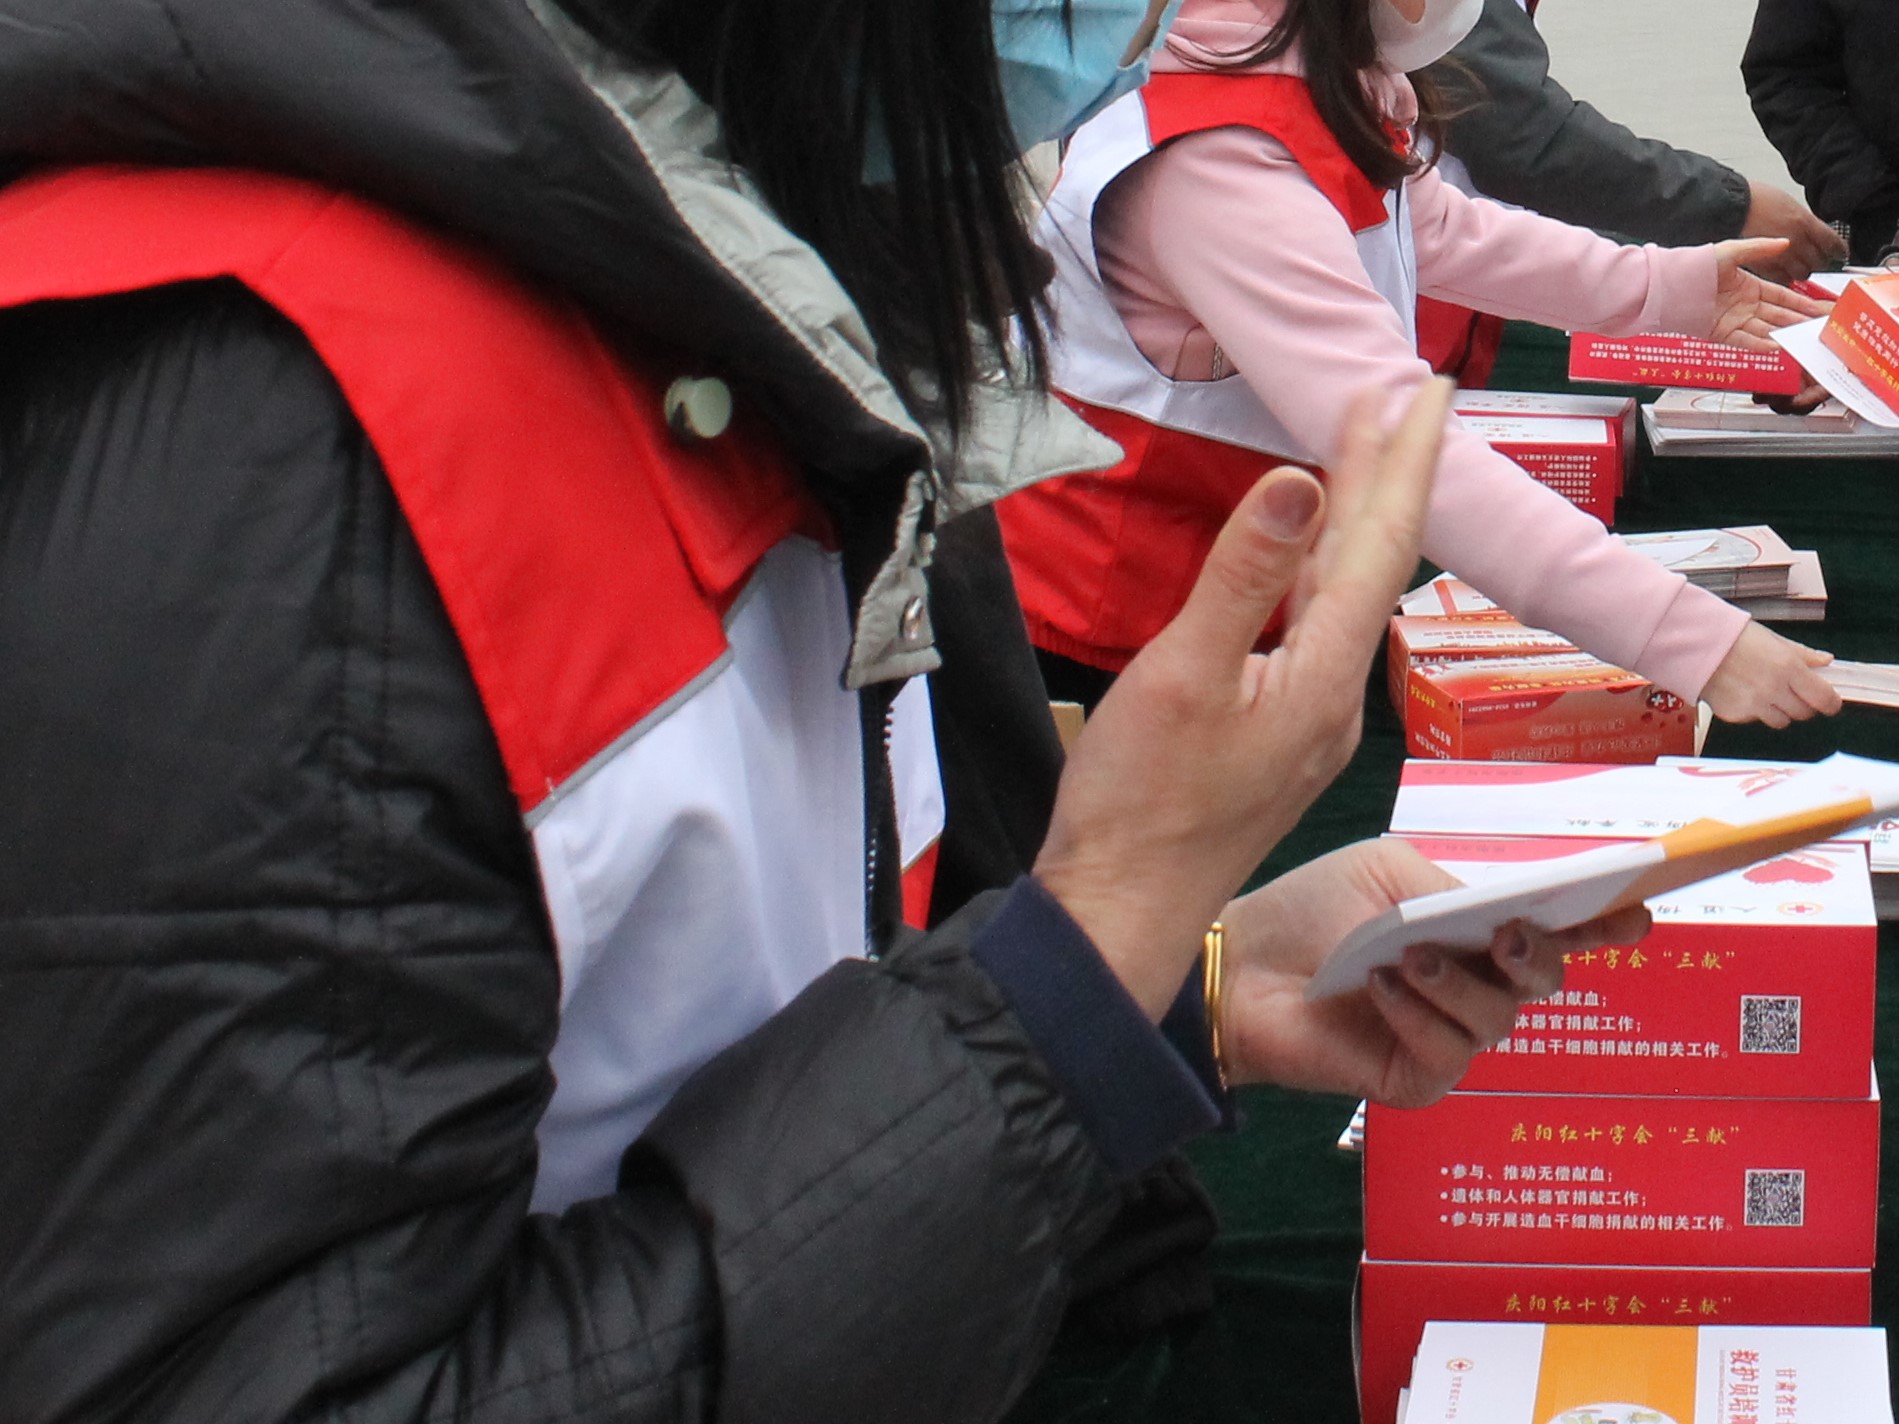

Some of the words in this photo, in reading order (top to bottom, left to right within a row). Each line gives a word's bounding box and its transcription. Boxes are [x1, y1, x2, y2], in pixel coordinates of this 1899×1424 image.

[1511, 1123, 1653, 1144] 庆阳红十字会
[1505, 1295, 1647, 1316] 庆阳红十字会
[1774, 1367, 1798, 1424] 甘肃省红
